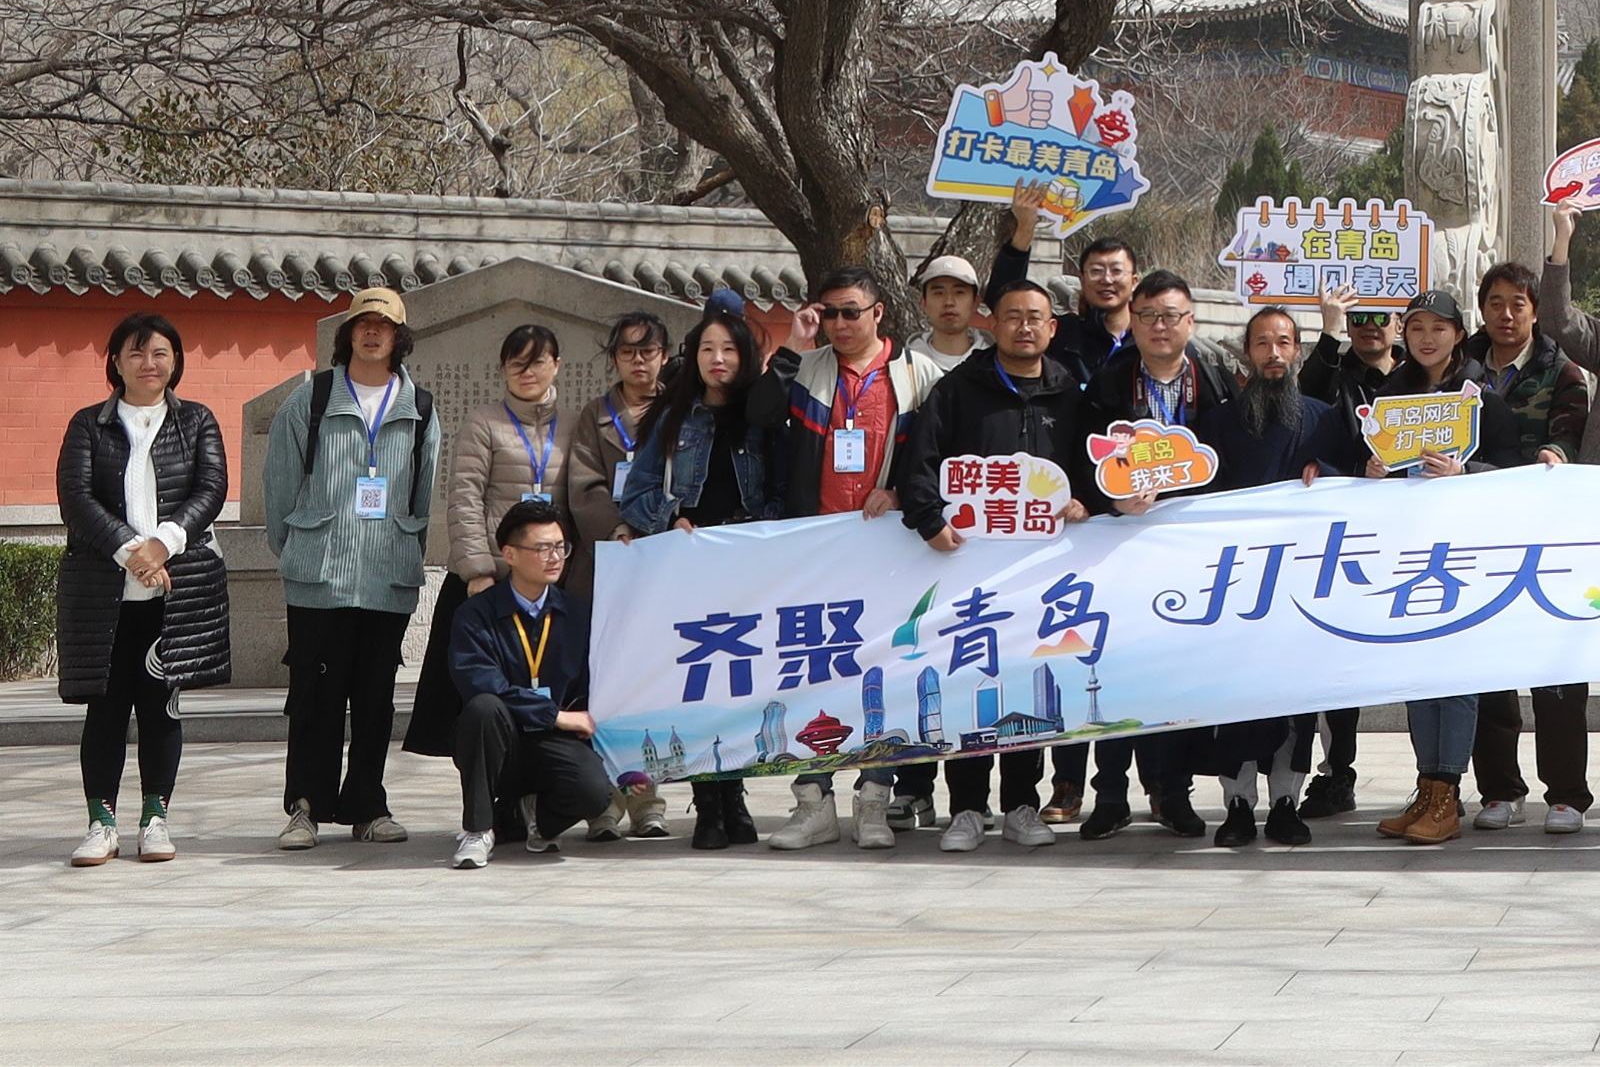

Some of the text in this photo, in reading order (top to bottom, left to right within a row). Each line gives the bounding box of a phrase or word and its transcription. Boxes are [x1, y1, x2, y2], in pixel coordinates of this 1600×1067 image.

[944, 128, 1119, 182] 打卡最美青岛
[1300, 228, 1400, 261] 在青岛
[1284, 265, 1418, 297] 遇见春天
[1384, 401, 1462, 429] 青岛网红
[1130, 438, 1175, 465] 青岛
[1395, 426, 1454, 451] 打卡地
[946, 459, 1022, 496] 醉美
[1129, 460, 1194, 492] 我来了
[984, 498, 1056, 535] 青岛
